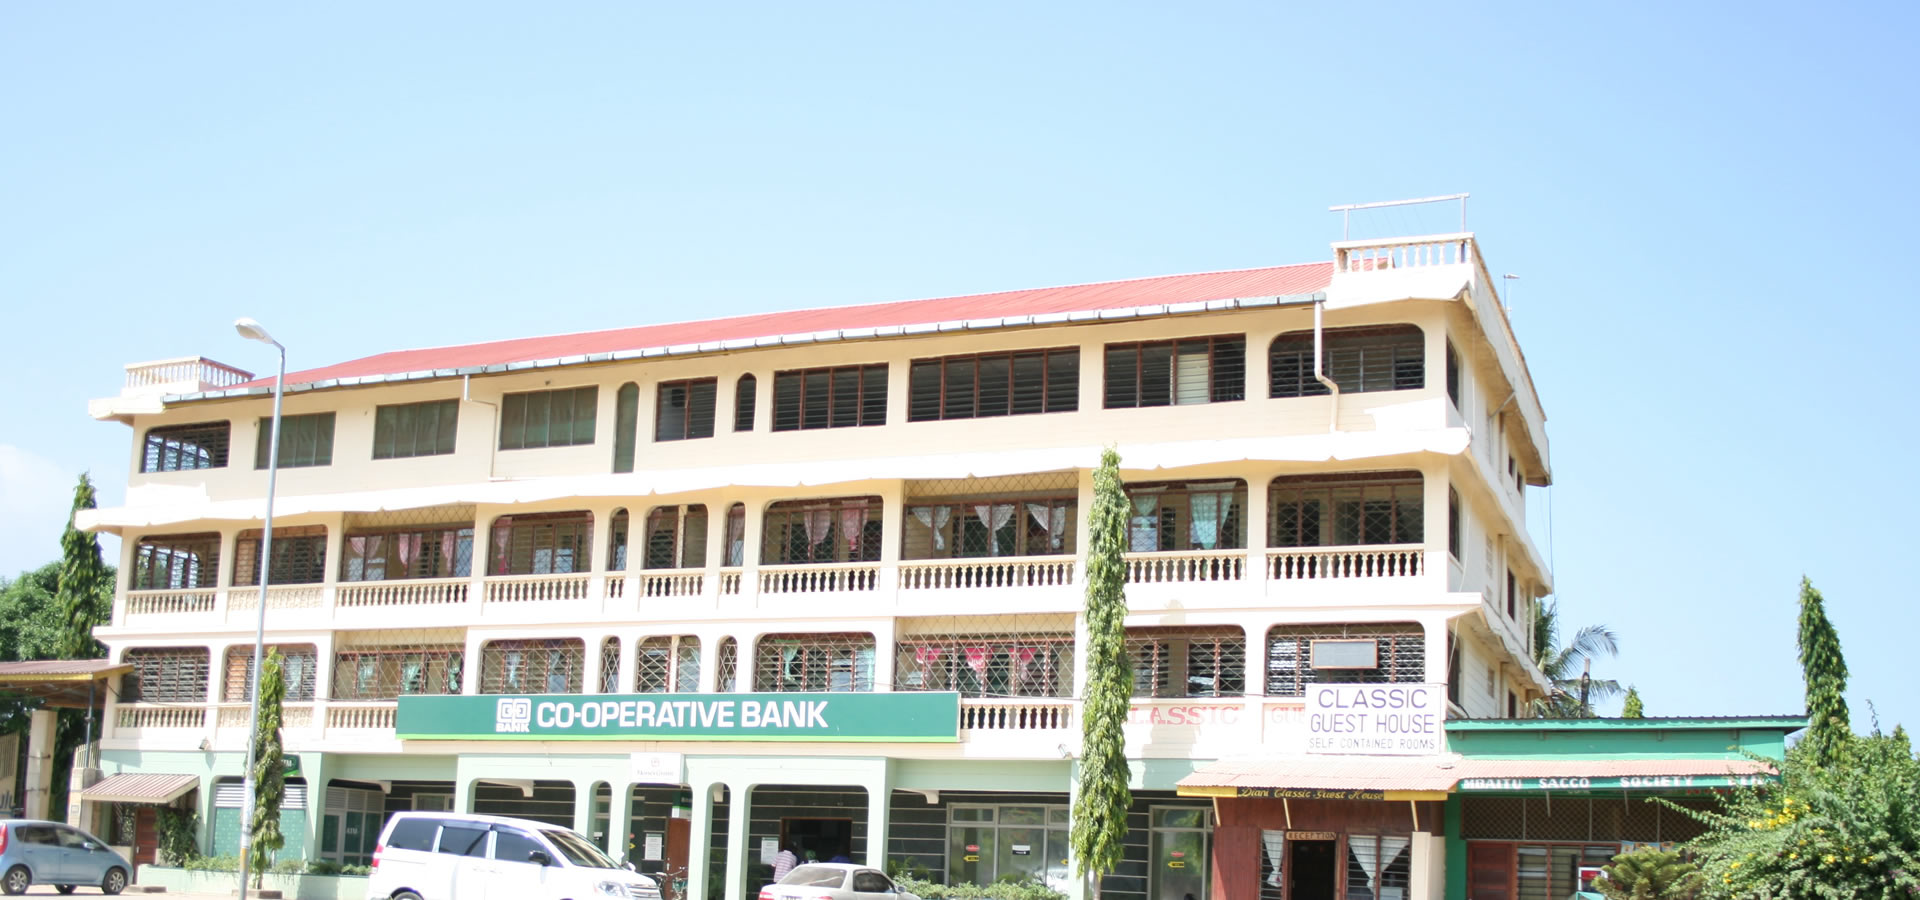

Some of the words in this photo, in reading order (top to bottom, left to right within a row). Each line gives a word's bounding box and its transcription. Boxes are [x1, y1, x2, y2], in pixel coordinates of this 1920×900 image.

[1318, 688, 1427, 709] CLASSIC
[537, 702, 735, 728] CO-OPERATIVE
[741, 700, 829, 728] BANK
[1113, 706, 1239, 725] LASSIC
[495, 722, 530, 733] BANK
[1310, 713, 1368, 733] GUEST
[1376, 714, 1435, 734] HOUSE
[1309, 738, 1334, 749] SELF
[1340, 738, 1394, 750] CONTAINED
[1400, 738, 1435, 750] ROOMS
[1538, 778, 1590, 789] SACCO
[1620, 776, 1694, 788] SOCIETY
[1274, 788, 1311, 798] Classic
[1312, 789, 1346, 800] Guest
[1348, 789, 1384, 800] House
